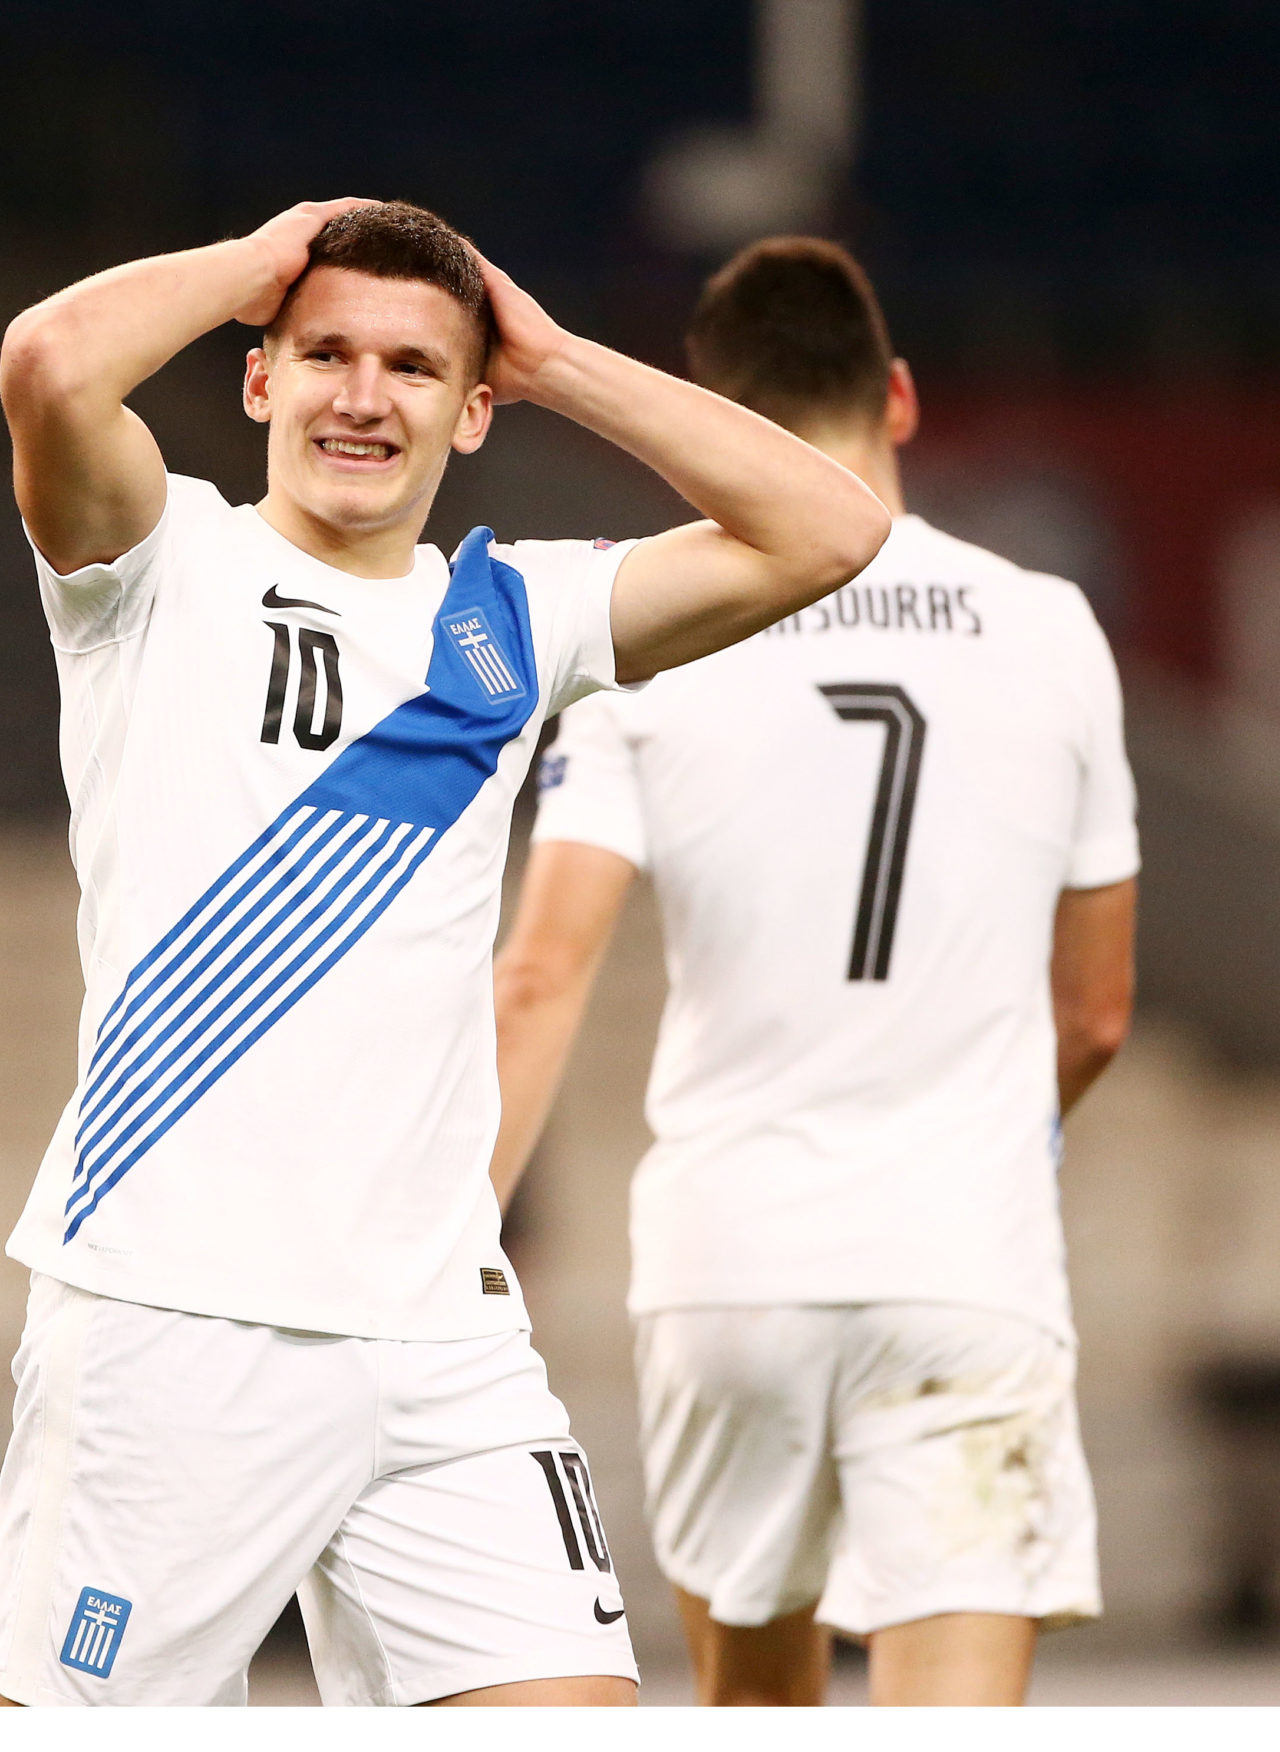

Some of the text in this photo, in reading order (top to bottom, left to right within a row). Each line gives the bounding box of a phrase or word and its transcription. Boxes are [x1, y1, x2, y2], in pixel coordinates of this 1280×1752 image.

[763, 585, 982, 636] SOURAS
[260, 620, 344, 752] 10
[817, 683, 927, 982] 7
[529, 1450, 611, 1575] 10
